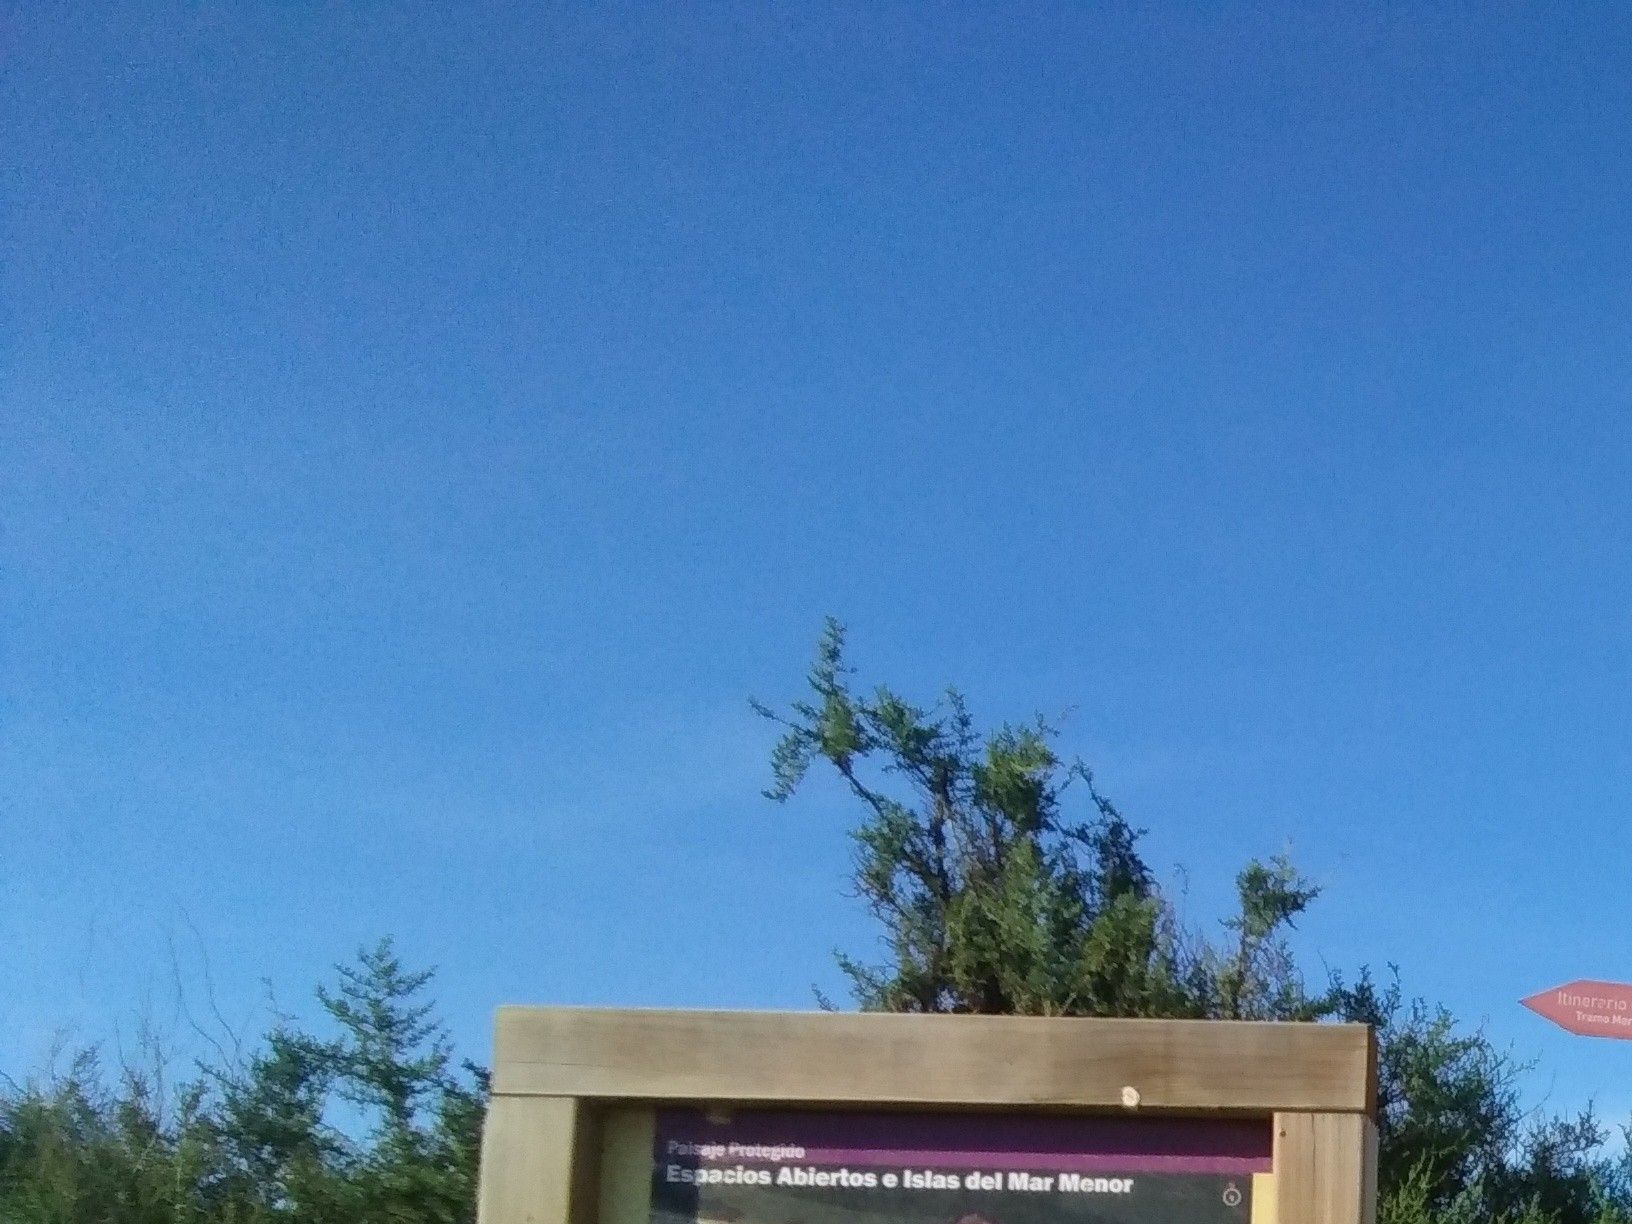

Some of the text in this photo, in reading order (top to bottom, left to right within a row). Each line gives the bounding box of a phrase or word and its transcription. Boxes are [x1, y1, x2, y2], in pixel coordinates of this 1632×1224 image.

[1557, 991, 1627, 1011] Itinerario
[1576, 1010, 1610, 1024] Tramo
[1612, 1014, 1632, 1026] Mar
[667, 1140, 806, 1162] Paisaje Protegido
[666, 1164, 1135, 1194] Espacios Abiertos e Islas del Mar Menor
